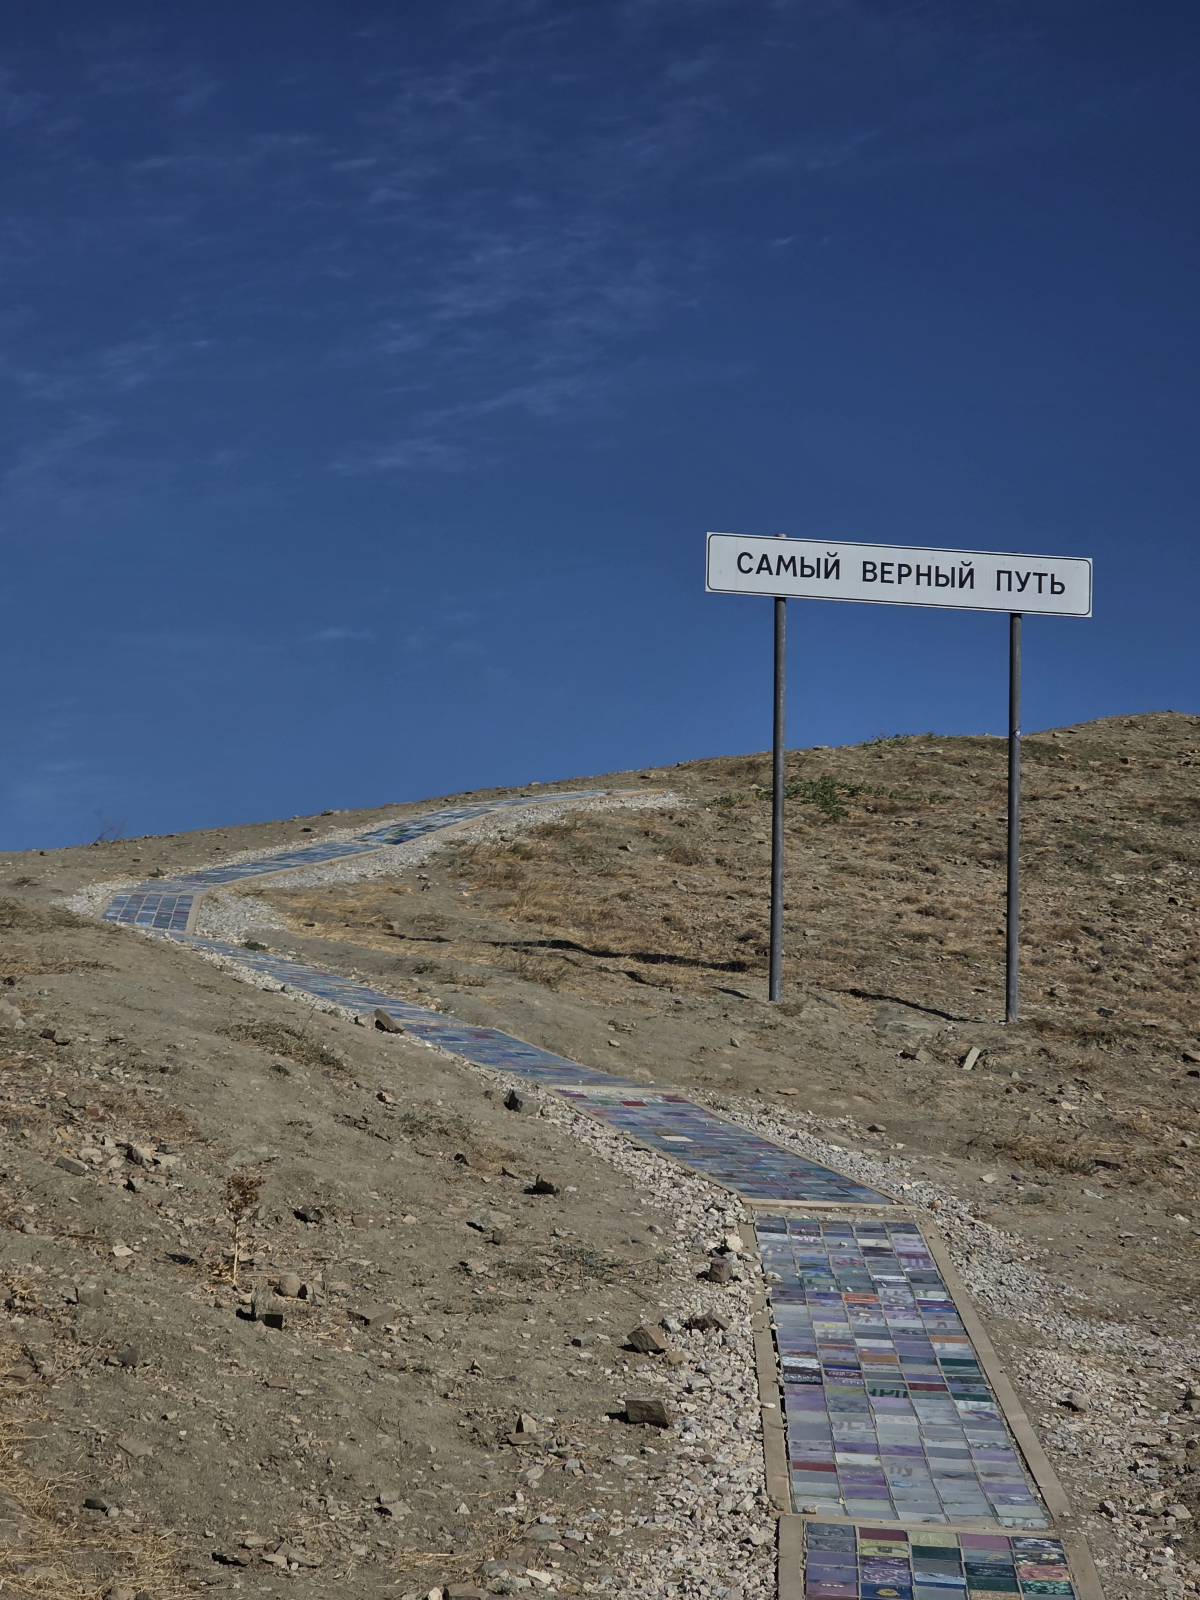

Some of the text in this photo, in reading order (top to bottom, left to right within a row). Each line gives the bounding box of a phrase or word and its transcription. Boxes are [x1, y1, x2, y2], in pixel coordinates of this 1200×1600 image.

[736, 551, 1066, 595] САМЫЙ ВЕРНЫЙ ПУТЬ
